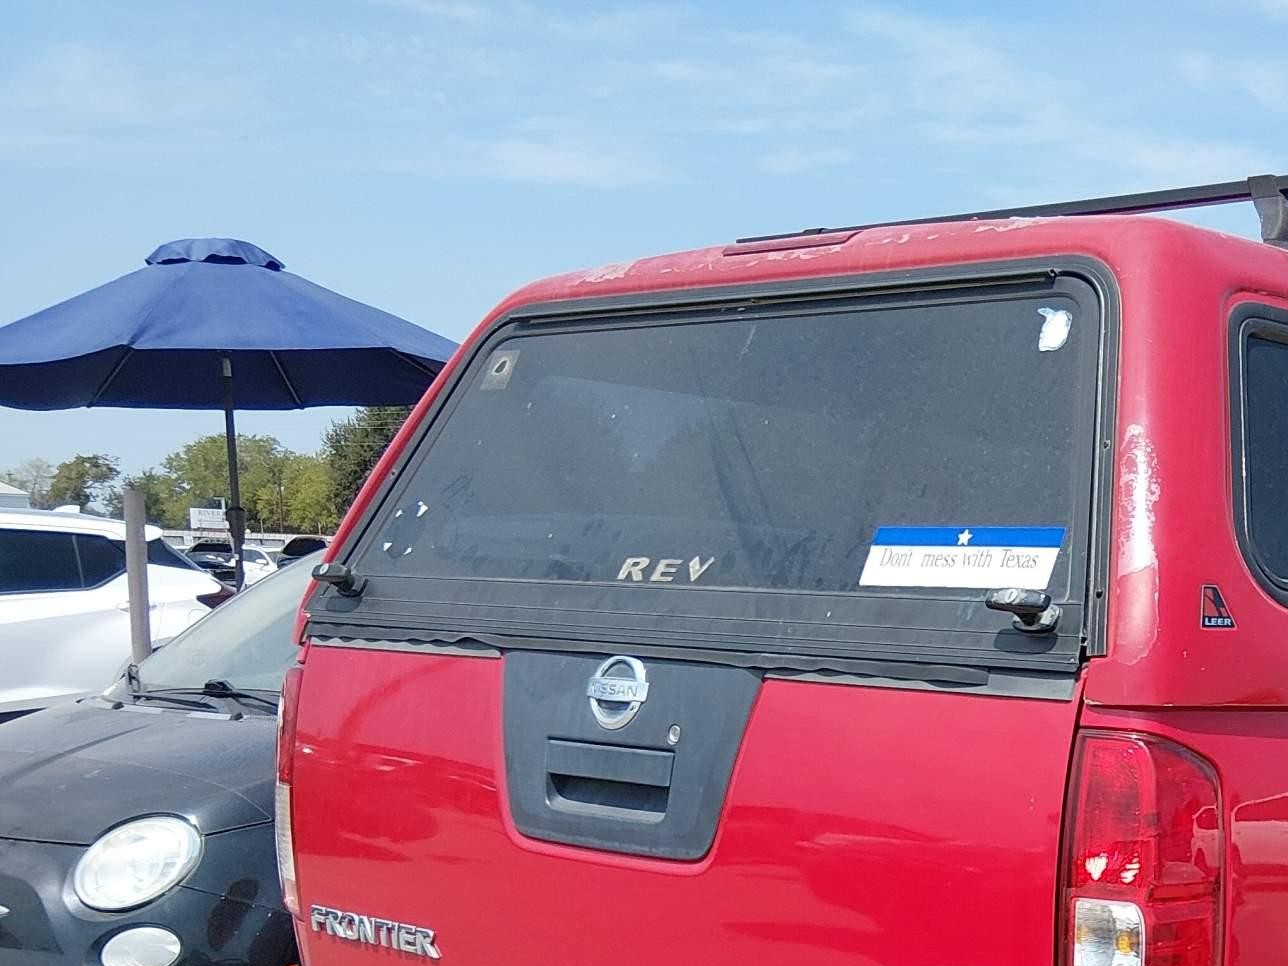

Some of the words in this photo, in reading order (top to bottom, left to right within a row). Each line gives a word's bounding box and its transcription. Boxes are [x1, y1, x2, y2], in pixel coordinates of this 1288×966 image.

[616, 555, 715, 582] REV
[920, 552, 958, 568] mess
[961, 549, 993, 568] with
[999, 548, 1039, 569] Texas
[1204, 617, 1232, 626] LEER
[592, 681, 638, 698] NISSAN
[311, 904, 442, 959] FRONTIER
